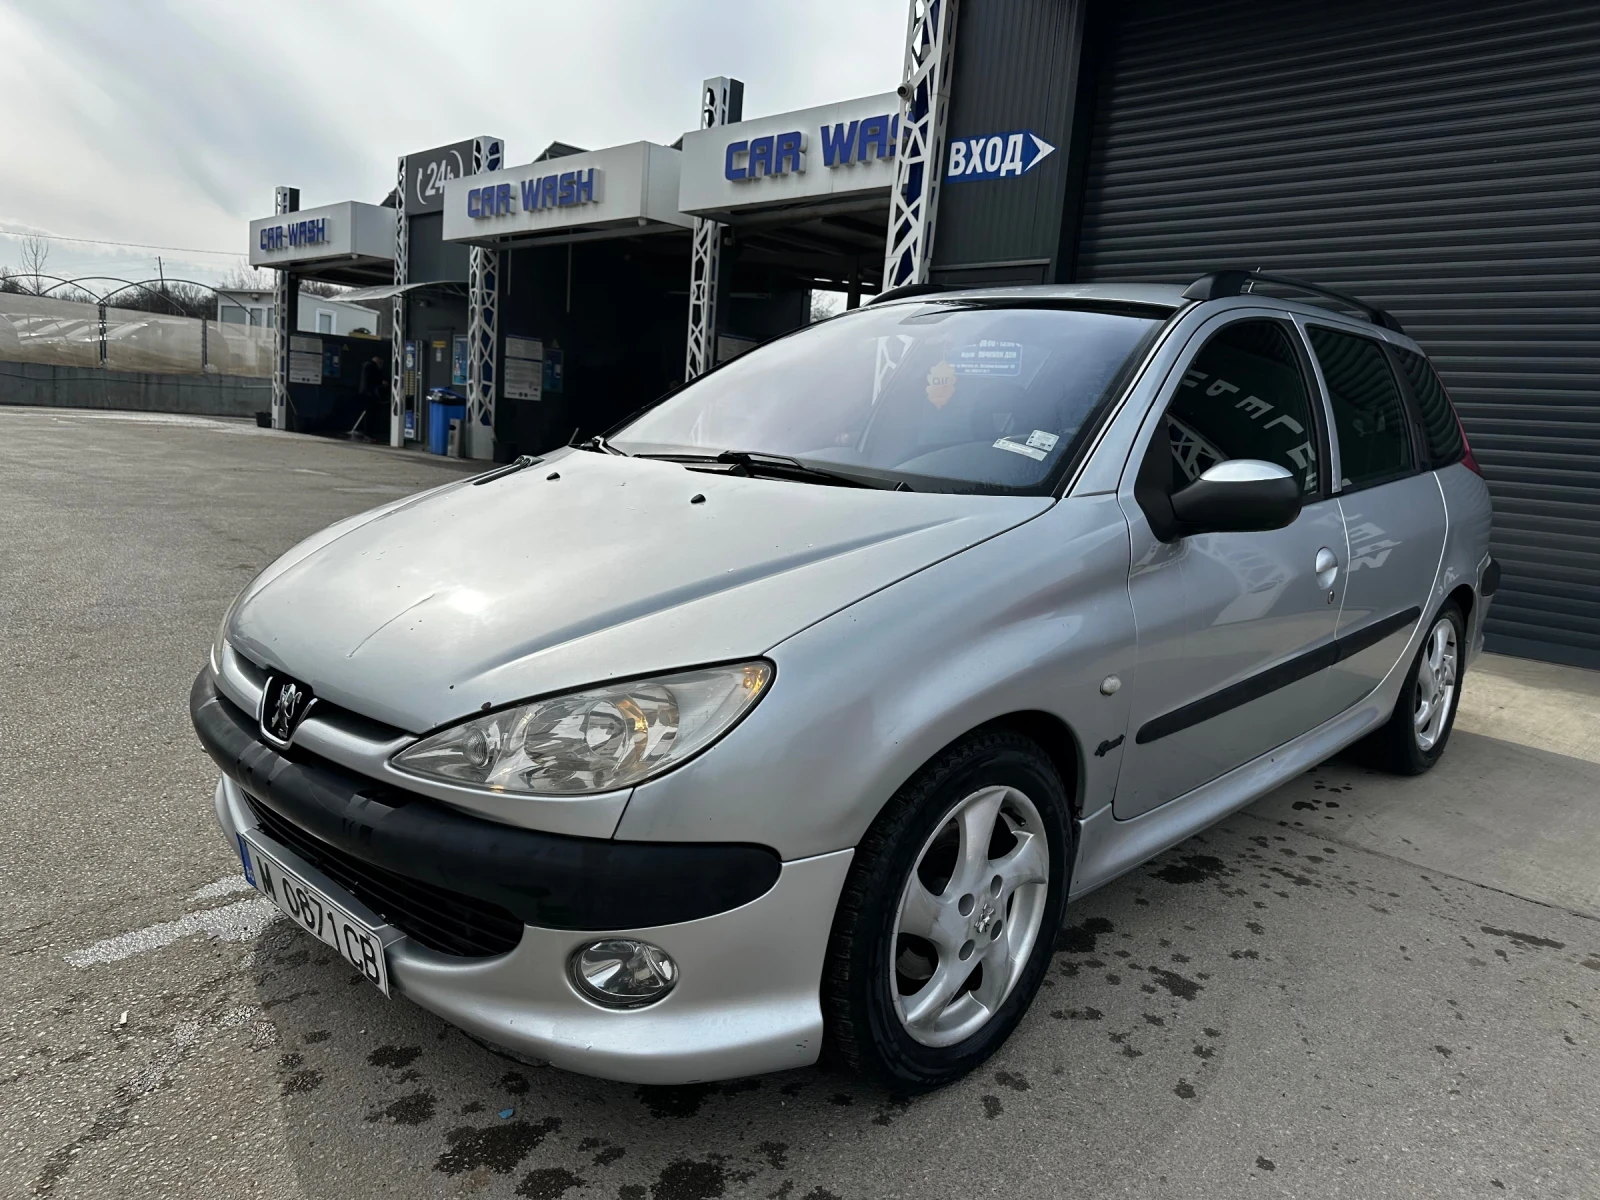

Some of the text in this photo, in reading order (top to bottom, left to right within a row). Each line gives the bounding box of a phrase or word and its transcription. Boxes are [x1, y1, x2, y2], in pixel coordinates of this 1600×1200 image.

[724, 130, 803, 181] CAR
[948, 133, 1024, 177] ВХОД
[467, 167, 594, 219] CAR WASH
[260, 217, 325, 250] CAR WASH
[256, 855, 381, 985] M 0871 CB
